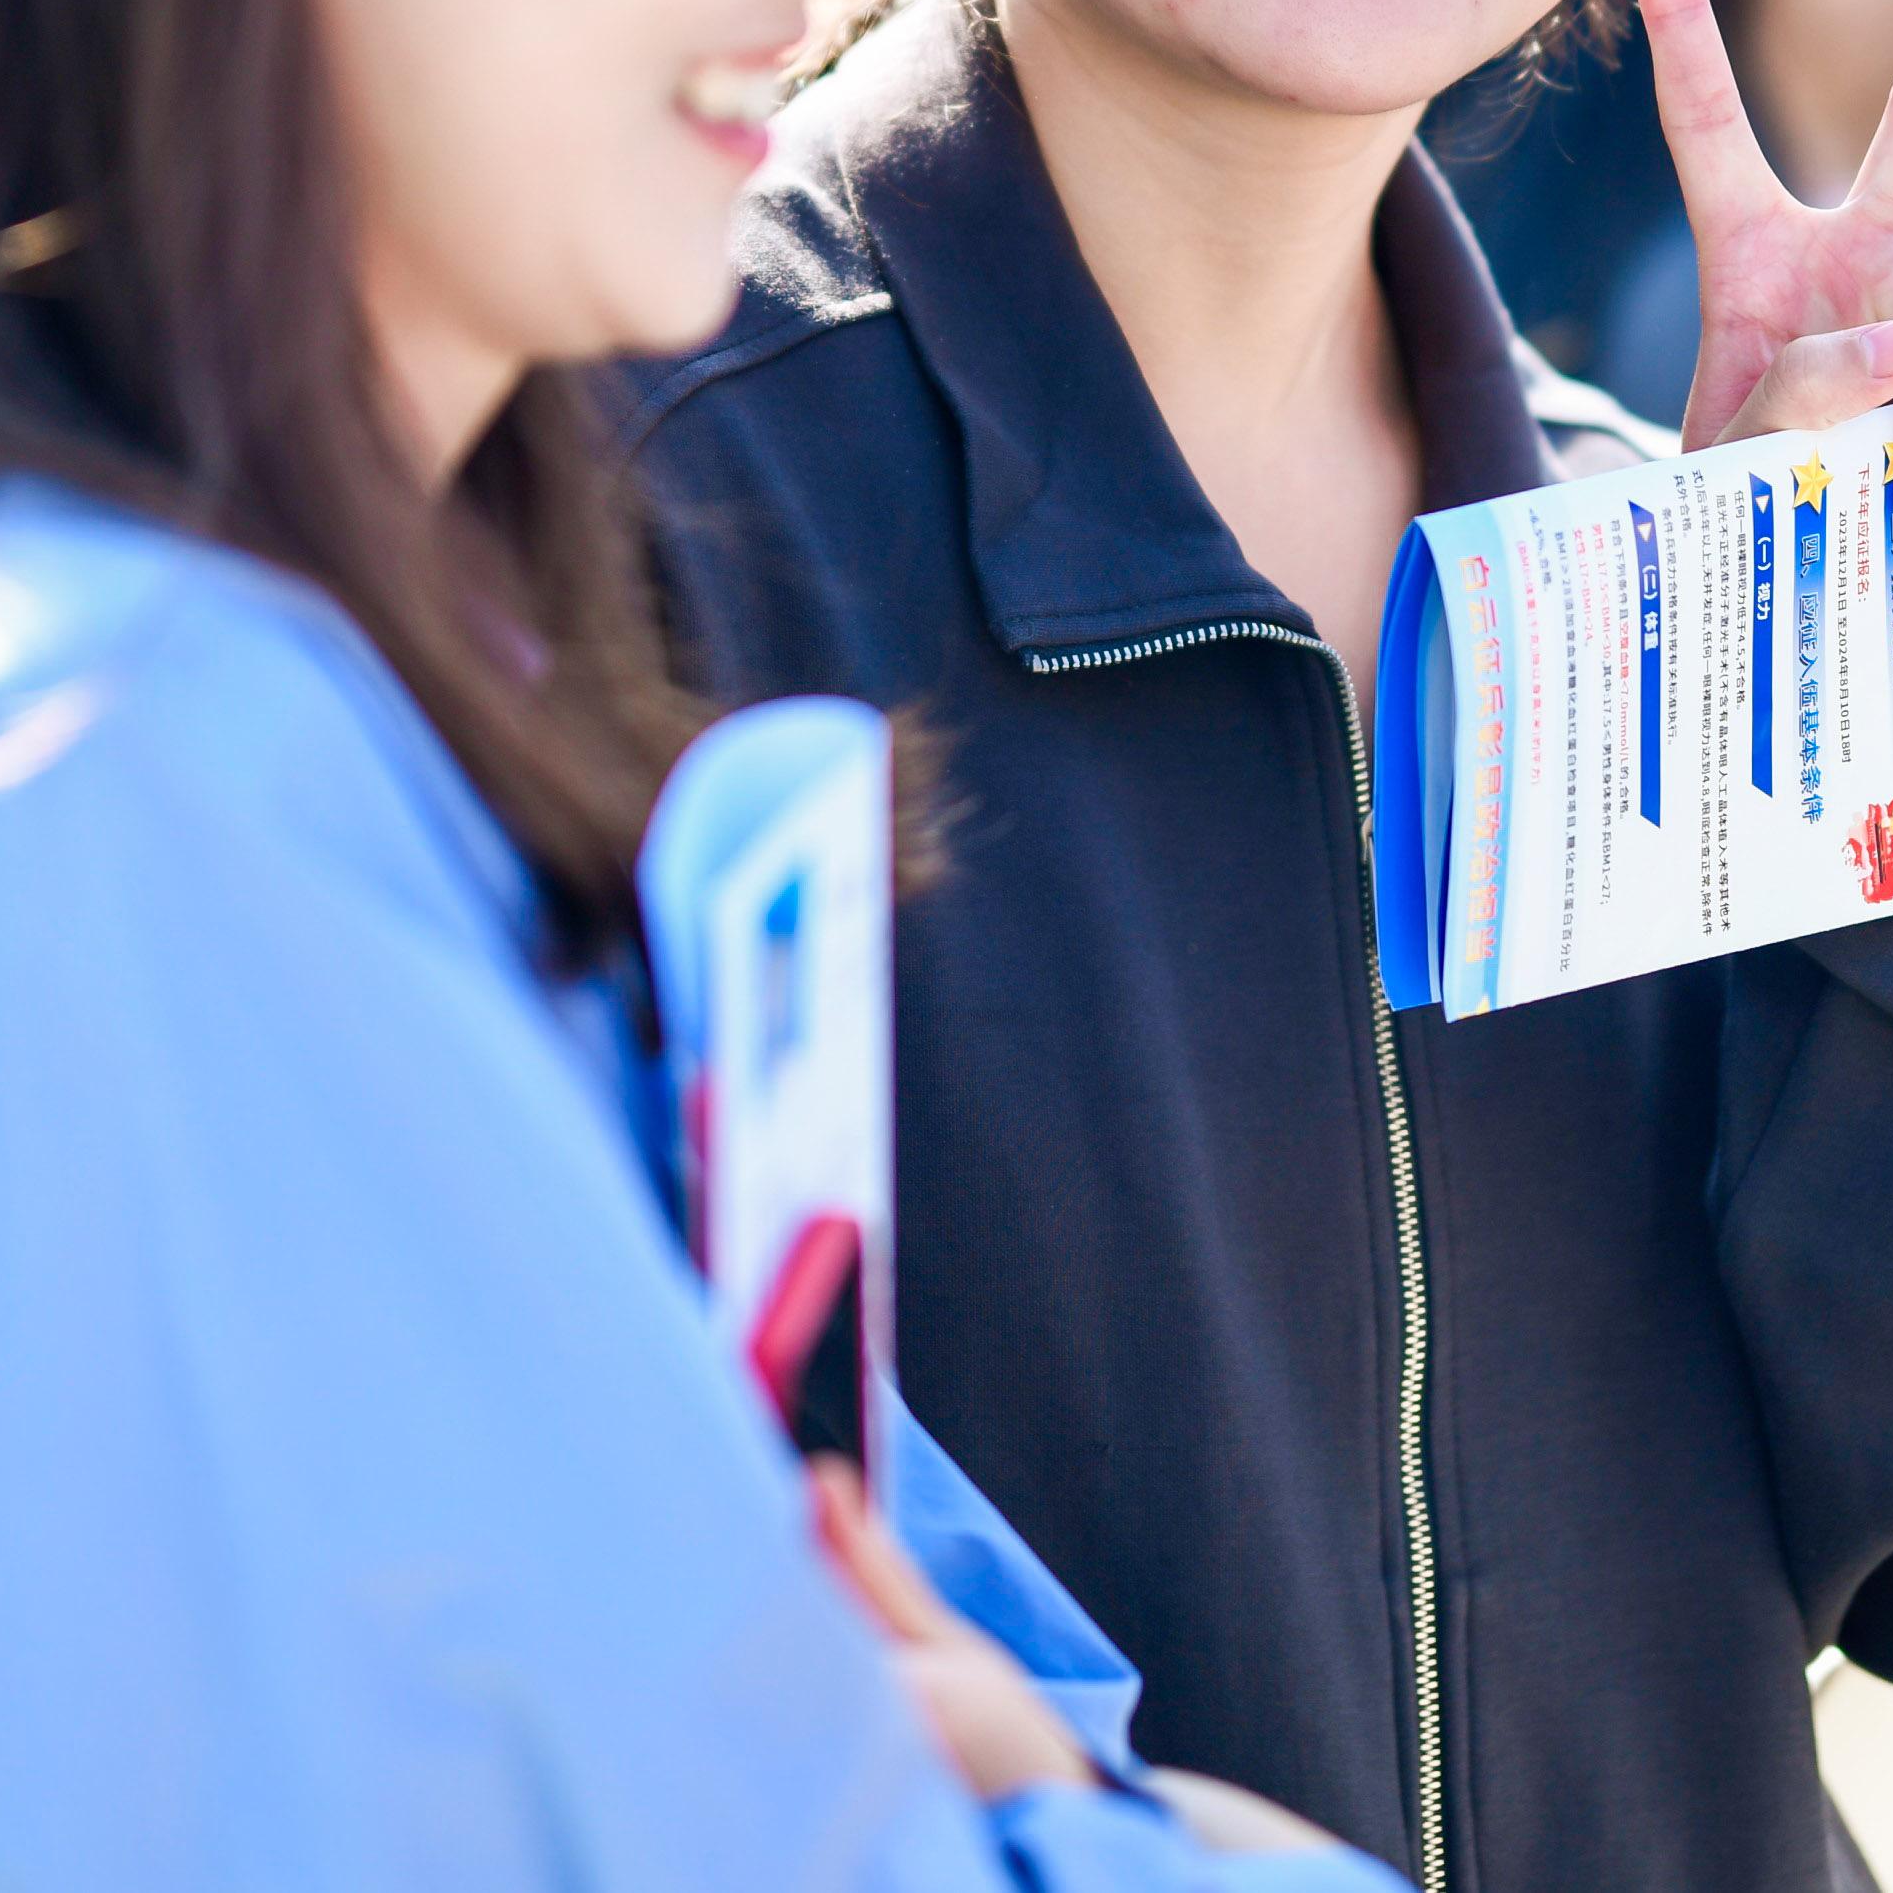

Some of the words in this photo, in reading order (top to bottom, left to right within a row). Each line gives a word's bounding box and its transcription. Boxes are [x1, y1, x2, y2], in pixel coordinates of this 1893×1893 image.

[1640, 561, 1659, 652] （二）体重
[1755, 534, 1773, 621] （一）视力
[1836, 510, 1849, 612] 2023年12月1日
[1800, 532, 1827, 826] 四、应征入伍基本条件
[1836, 615, 1854, 764] 至2024年8月10日18时
